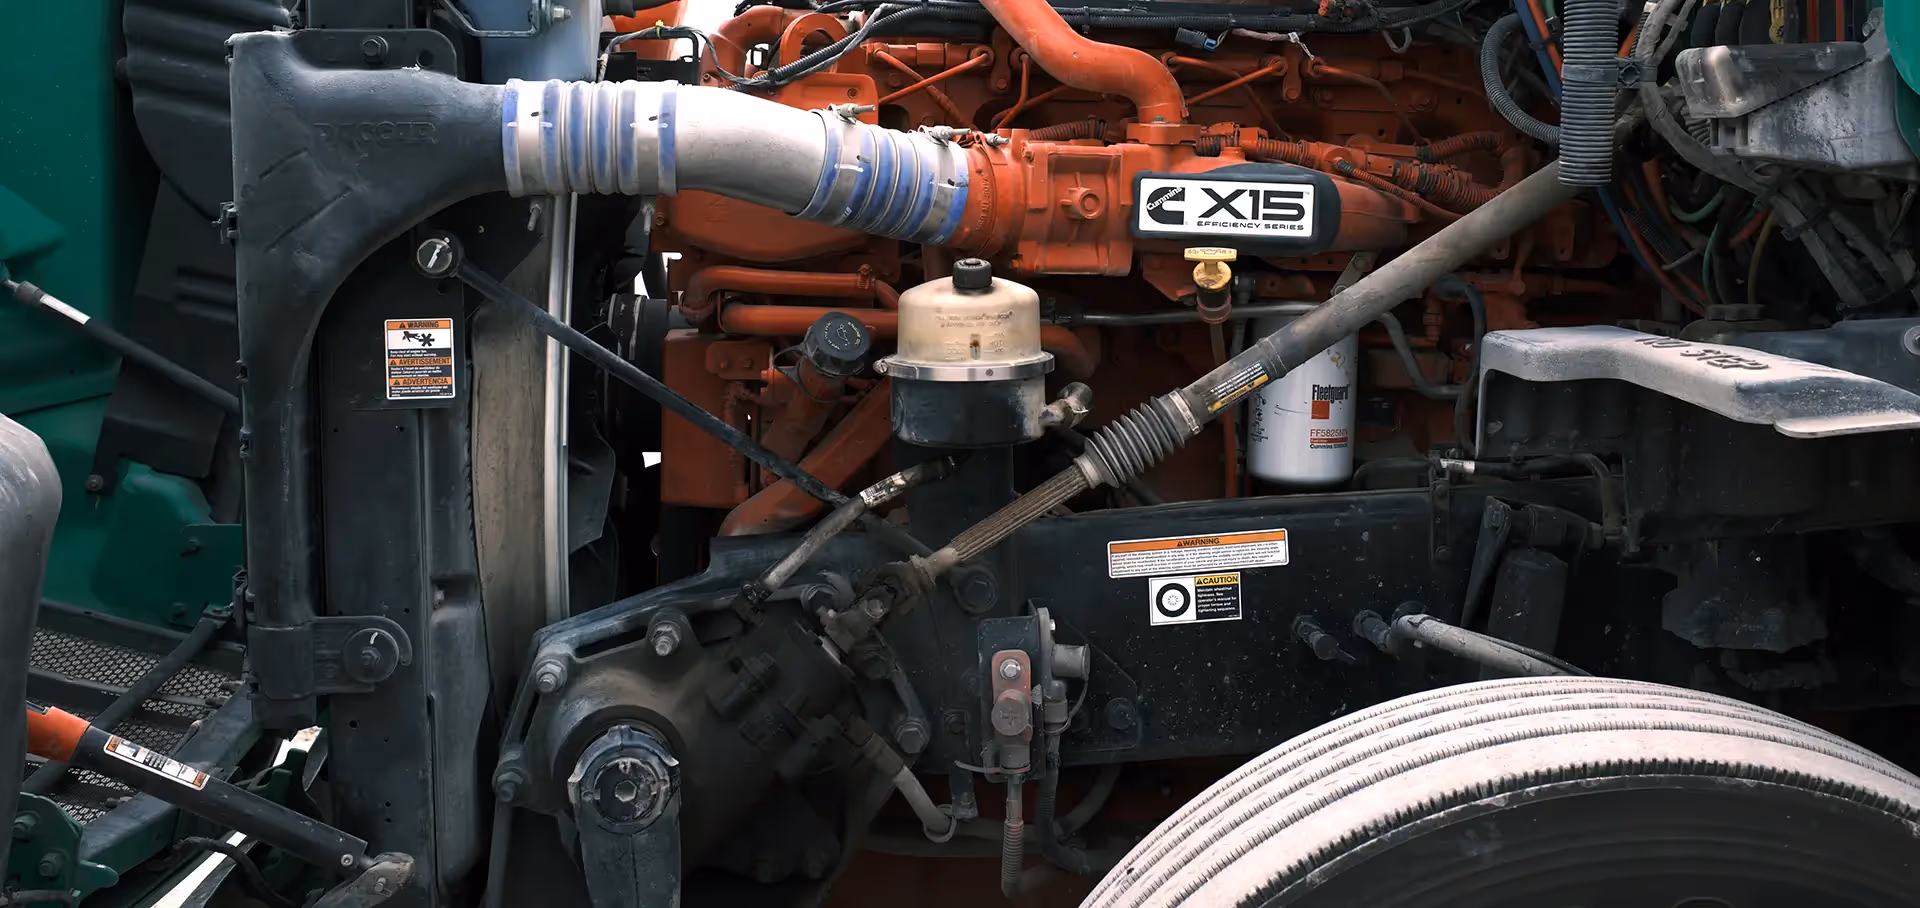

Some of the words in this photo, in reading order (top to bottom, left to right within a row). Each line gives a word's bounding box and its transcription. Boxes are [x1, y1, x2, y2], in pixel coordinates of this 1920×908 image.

[1146, 186, 1183, 211] Cummins
[1198, 188, 1306, 222] X15
[1680, 349, 1770, 370] STEP
[1312, 384, 1348, 403] Fleetguard
[1183, 538, 1220, 546] WARNING
[1203, 576, 1238, 584] CAUTION
